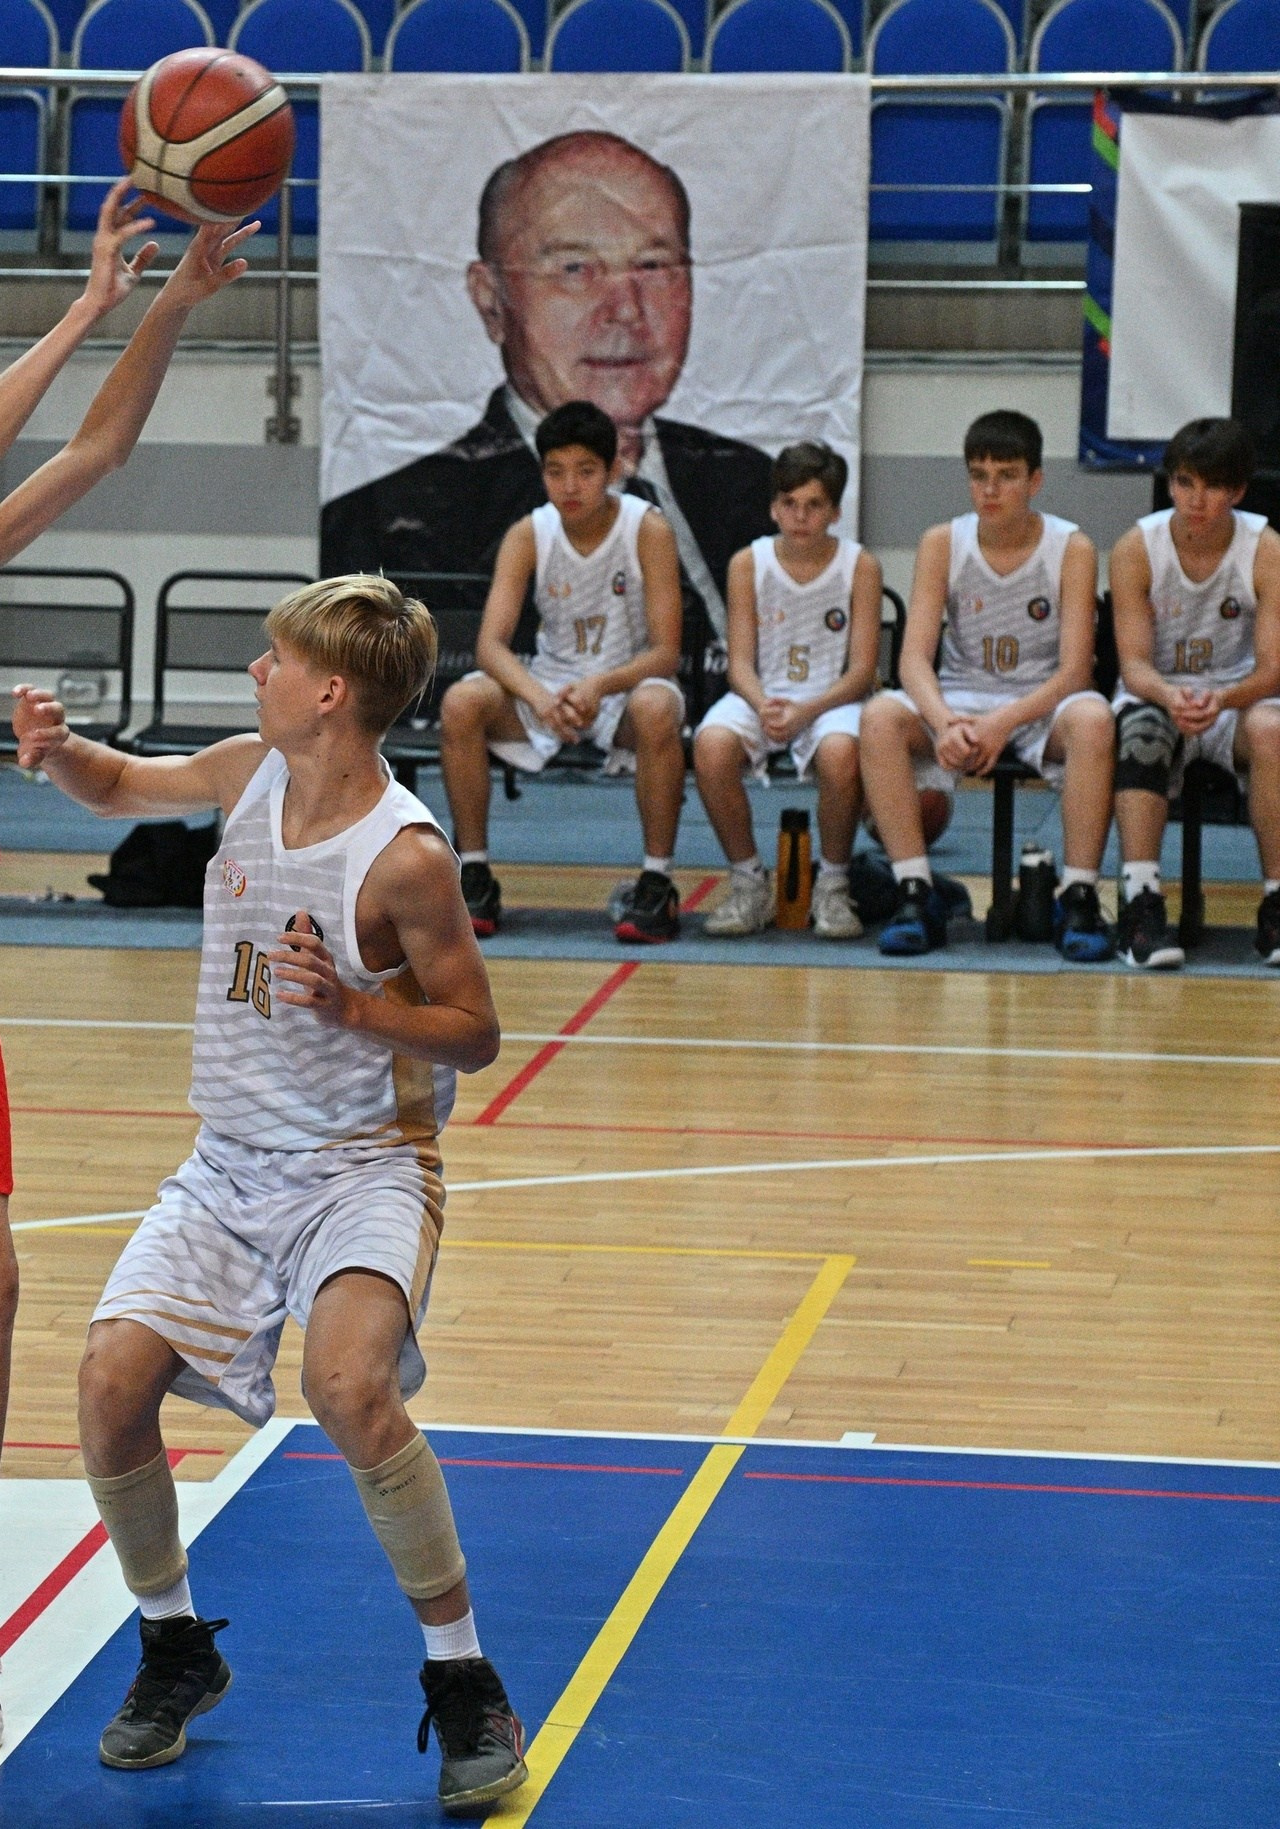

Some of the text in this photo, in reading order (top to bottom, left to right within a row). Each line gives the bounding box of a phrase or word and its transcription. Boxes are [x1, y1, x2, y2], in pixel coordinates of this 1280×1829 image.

[574, 614, 608, 655] 17
[982, 634, 1019, 672] 10
[787, 644, 810, 682] 5
[1173, 637, 1214, 675] 12
[226, 940, 271, 1020] 16
